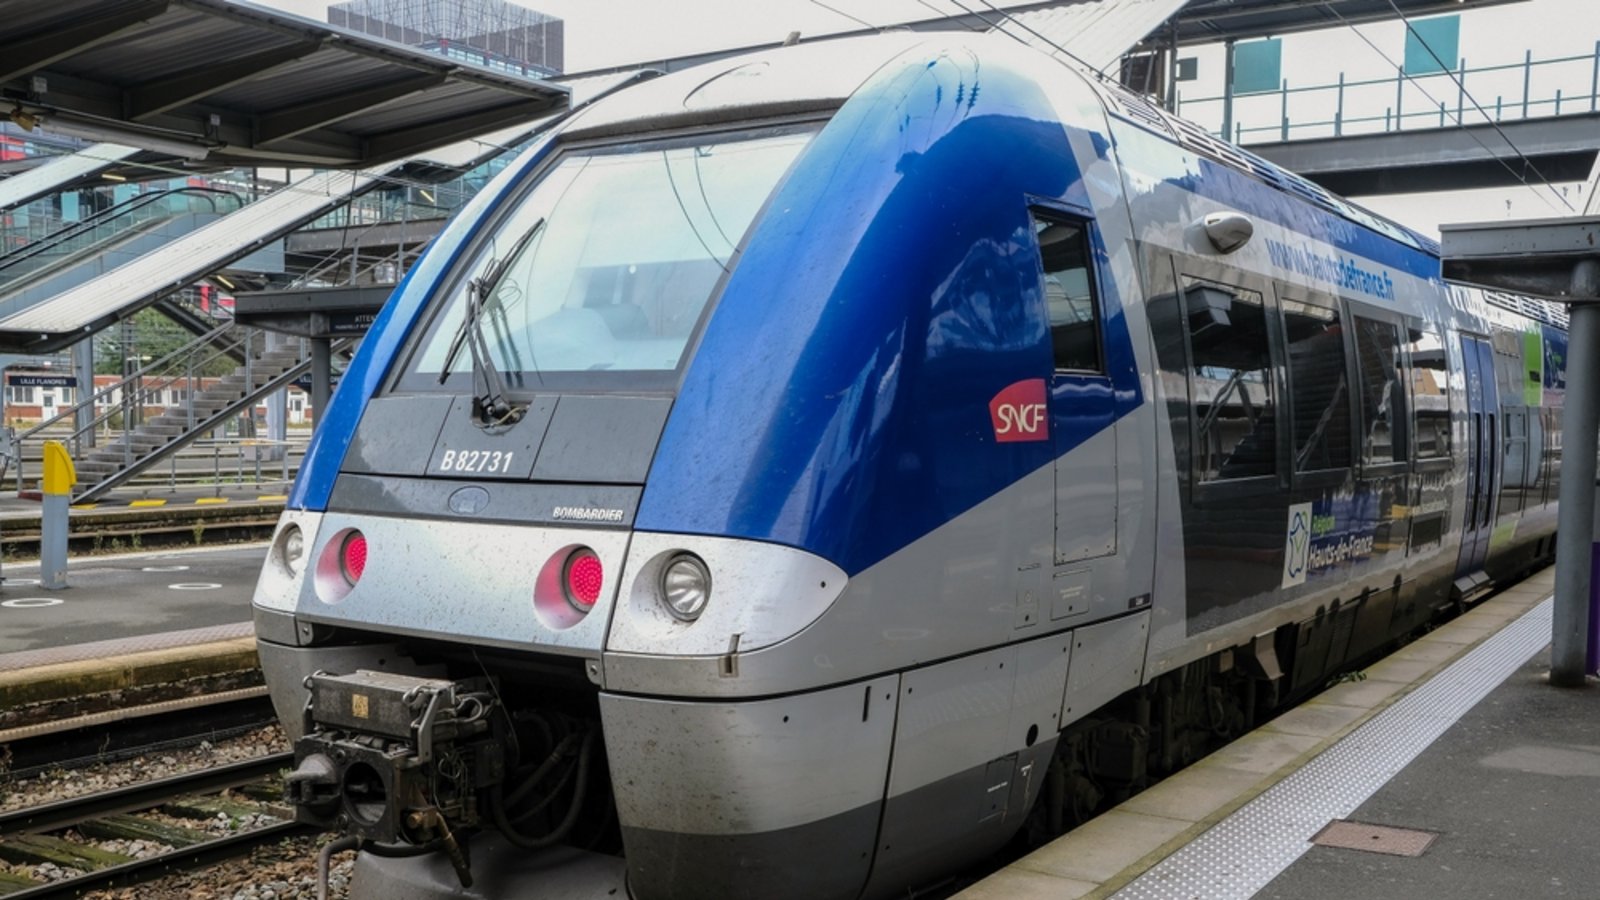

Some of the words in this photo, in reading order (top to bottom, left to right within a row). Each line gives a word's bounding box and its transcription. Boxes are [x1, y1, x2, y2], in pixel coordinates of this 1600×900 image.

[1264, 237, 1395, 301] www.hautsdefrance.fr
[996, 403, 1047, 434] SNCF
[440, 450, 454, 471] B
[455, 451, 514, 473] 82731
[552, 506, 624, 522] BOMBARDIER
[1308, 535, 1374, 570] Hauts-de-France
